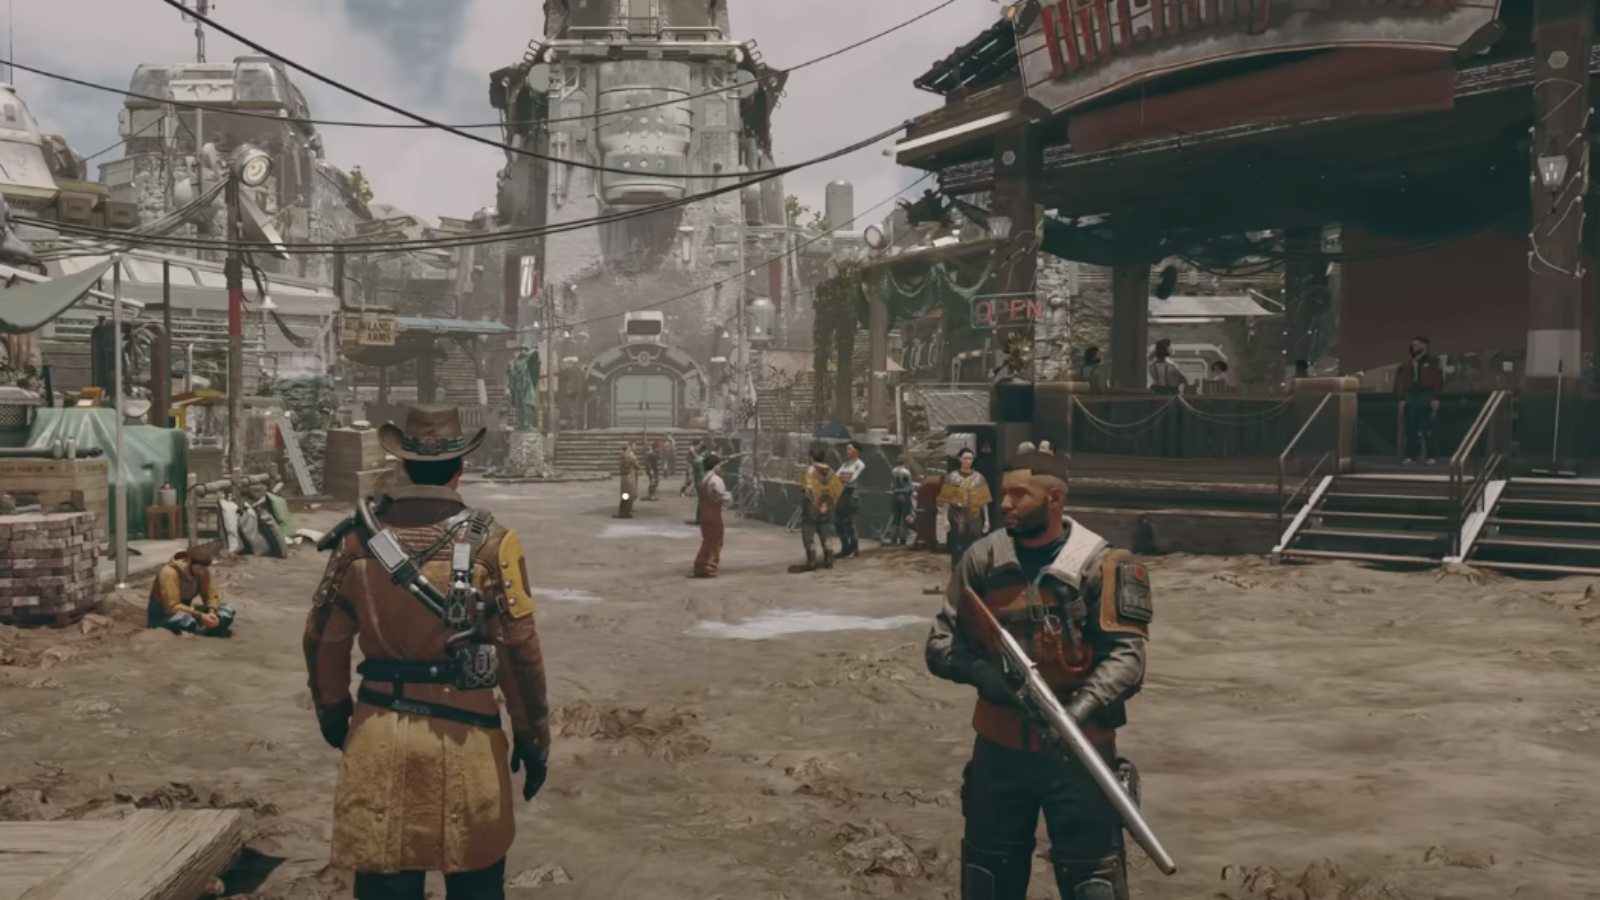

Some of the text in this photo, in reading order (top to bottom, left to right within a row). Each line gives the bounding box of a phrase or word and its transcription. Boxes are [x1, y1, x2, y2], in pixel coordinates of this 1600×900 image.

[974, 298, 1043, 322] OPEN
[344, 319, 391, 332] RWLAND
[367, 332, 391, 342] ARMS
